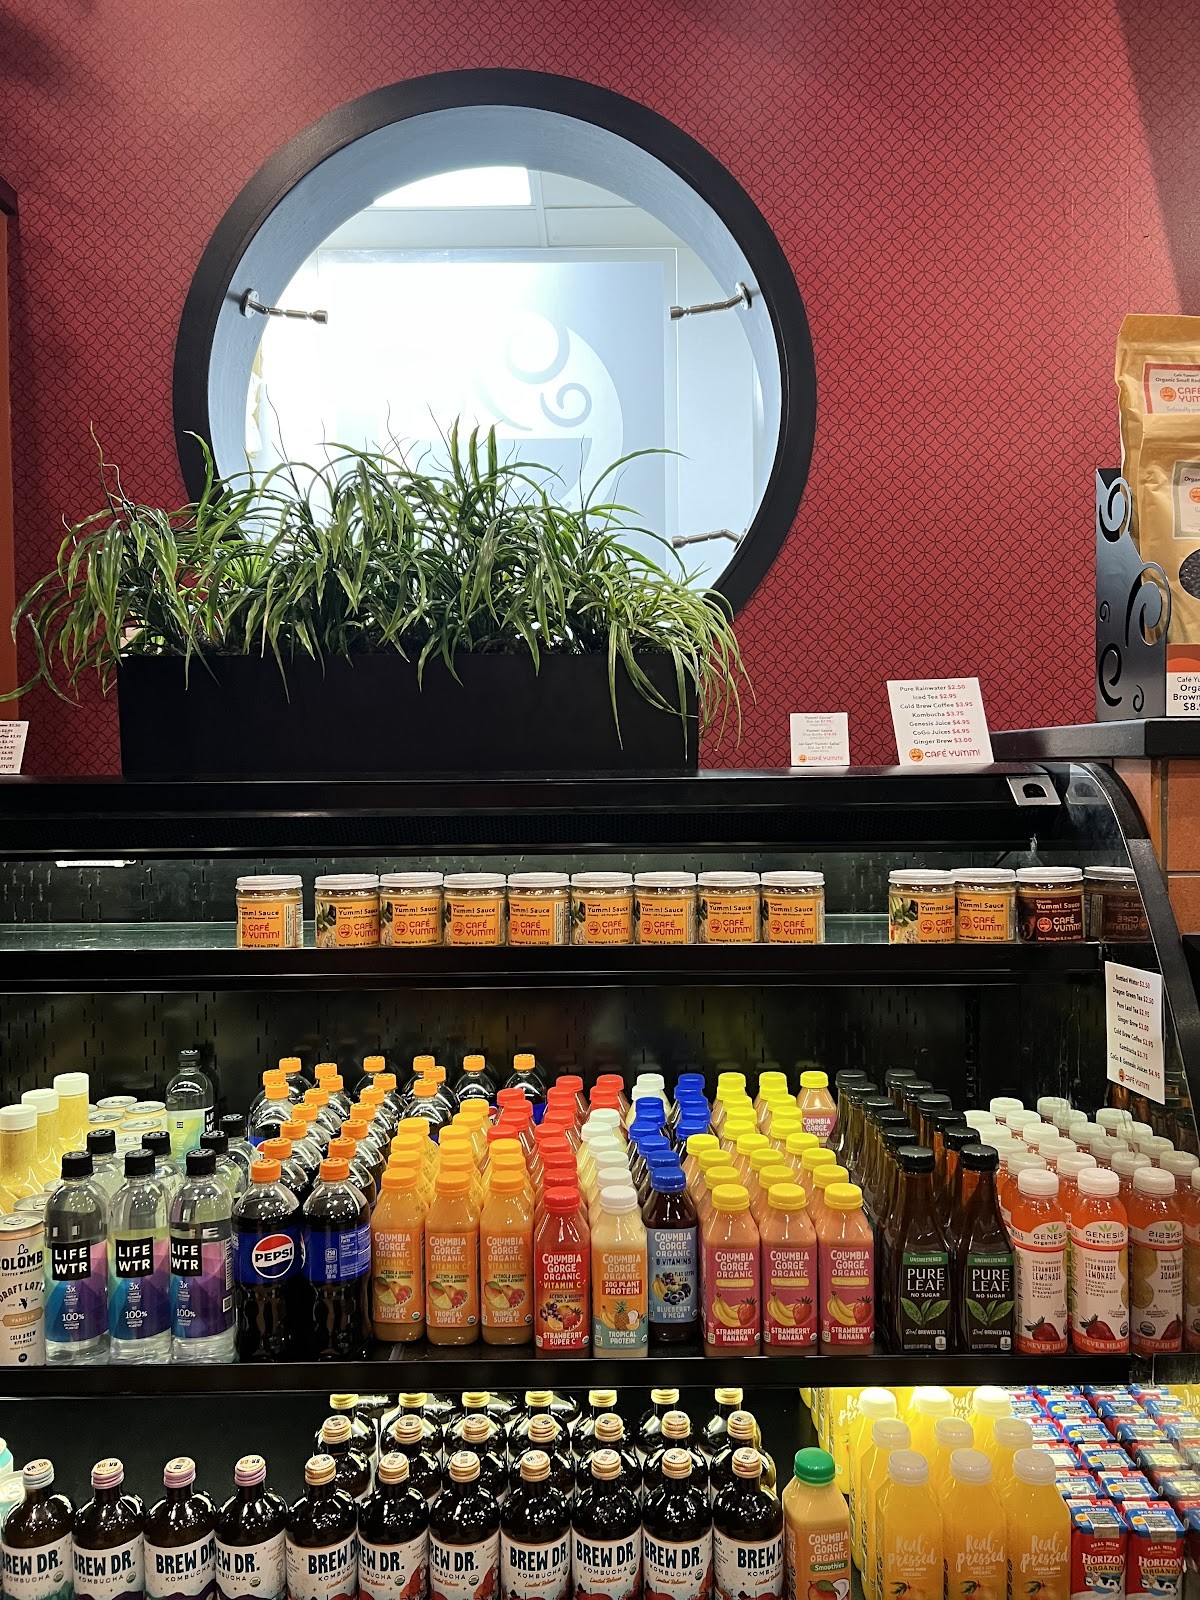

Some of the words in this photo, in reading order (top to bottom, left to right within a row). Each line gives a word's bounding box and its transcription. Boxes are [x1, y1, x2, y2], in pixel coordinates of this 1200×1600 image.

[925, 749, 947, 757] CAFÉ
[466, 920, 487, 929] CAFÉ
[973, 915, 996, 924] CAFÉ
[1053, 914, 1074, 924] CAFÉ
[374, 1232, 411, 1242] COLUMBIA
[430, 1236, 466, 1246] COLUMBIA
[487, 1236, 524, 1246] COLUMBIA
[655, 1232, 692, 1242] COLUMBIA
[17, 1244, 29, 1255] La
[118, 1244, 150, 1258] LIFE
[172, 1242, 198, 1256] LIFE
[379, 1242, 405, 1251] GORGE
[434, 1246, 462, 1255] GORGE
[491, 1246, 519, 1254] GORGE
[659, 1241, 687, 1250] GORGE
[55, 1247, 87, 1260] LIFE
[254, 1247, 293, 1263] PEPSI
[542, 1253, 582, 1264] COLUMBIA
[603, 1253, 641, 1264] COLUMBIA
[715, 1252, 754, 1262] COLUMBIA
[770, 1251, 809, 1261] COLUMBIA
[830, 1250, 869, 1260] COLUMBIA
[0, 1250, 43, 1271] OLOMB
[118, 1260, 150, 1272] WTR
[171, 1258, 198, 1270] WTR
[720, 1262, 750, 1270] GORGE
[775, 1260, 805, 1270] GORGE
[835, 1260, 864, 1269] GORGE
[54, 1262, 88, 1274] WTR
[547, 1264, 576, 1272] GORGE
[607, 1264, 636, 1273] GORGE
[907, 1268, 945, 1280] PURE
[972, 1269, 1010, 1280] PURE
[1085, 1270, 1116, 1280] LEMONADE
[907, 1280, 944, 1291] LEAF
[972, 1281, 1008, 1292] LEAF
[62, 1312, 84, 1322] 100%
[125, 1310, 148, 1319] 100%
[176, 1309, 196, 1317] 100%
[809, 1530, 848, 1545] COLUMBIA
[645, 1539, 677, 1568] BREW
[682, 1545, 703, 1568] DR.
[814, 1542, 844, 1554] GORGE
[510, 1546, 548, 1572] BREW
[576, 1540, 611, 1568] BREW
[616, 1542, 636, 1567] DR.
[737, 1544, 775, 1569] BREW
[811, 1551, 847, 1562] ORGANIC
[956, 1547, 1004, 1572] pressed
[1020, 1546, 1069, 1573] pressed
[1082, 1553, 1126, 1565] HORIZON
[37, 1550, 63, 1573] DR.
[111, 1550, 136, 1572] DR.
[156, 1550, 197, 1574] BREW
[234, 1554, 260, 1572] DR.
[308, 1552, 348, 1574] BREW
[380, 1552, 404, 1572] DR.
[454, 1552, 479, 1572] DR.
[815, 1562, 844, 1571] Smoothies
[1139, 1556, 1182, 1567] HORIZON
[166, 1564, 211, 1582] KOMBUCHA
[518, 1567, 561, 1579] KOMBUCHA
[583, 1565, 627, 1576] KOMBUCHA
[650, 1565, 693, 1577] KOMBUCHA
